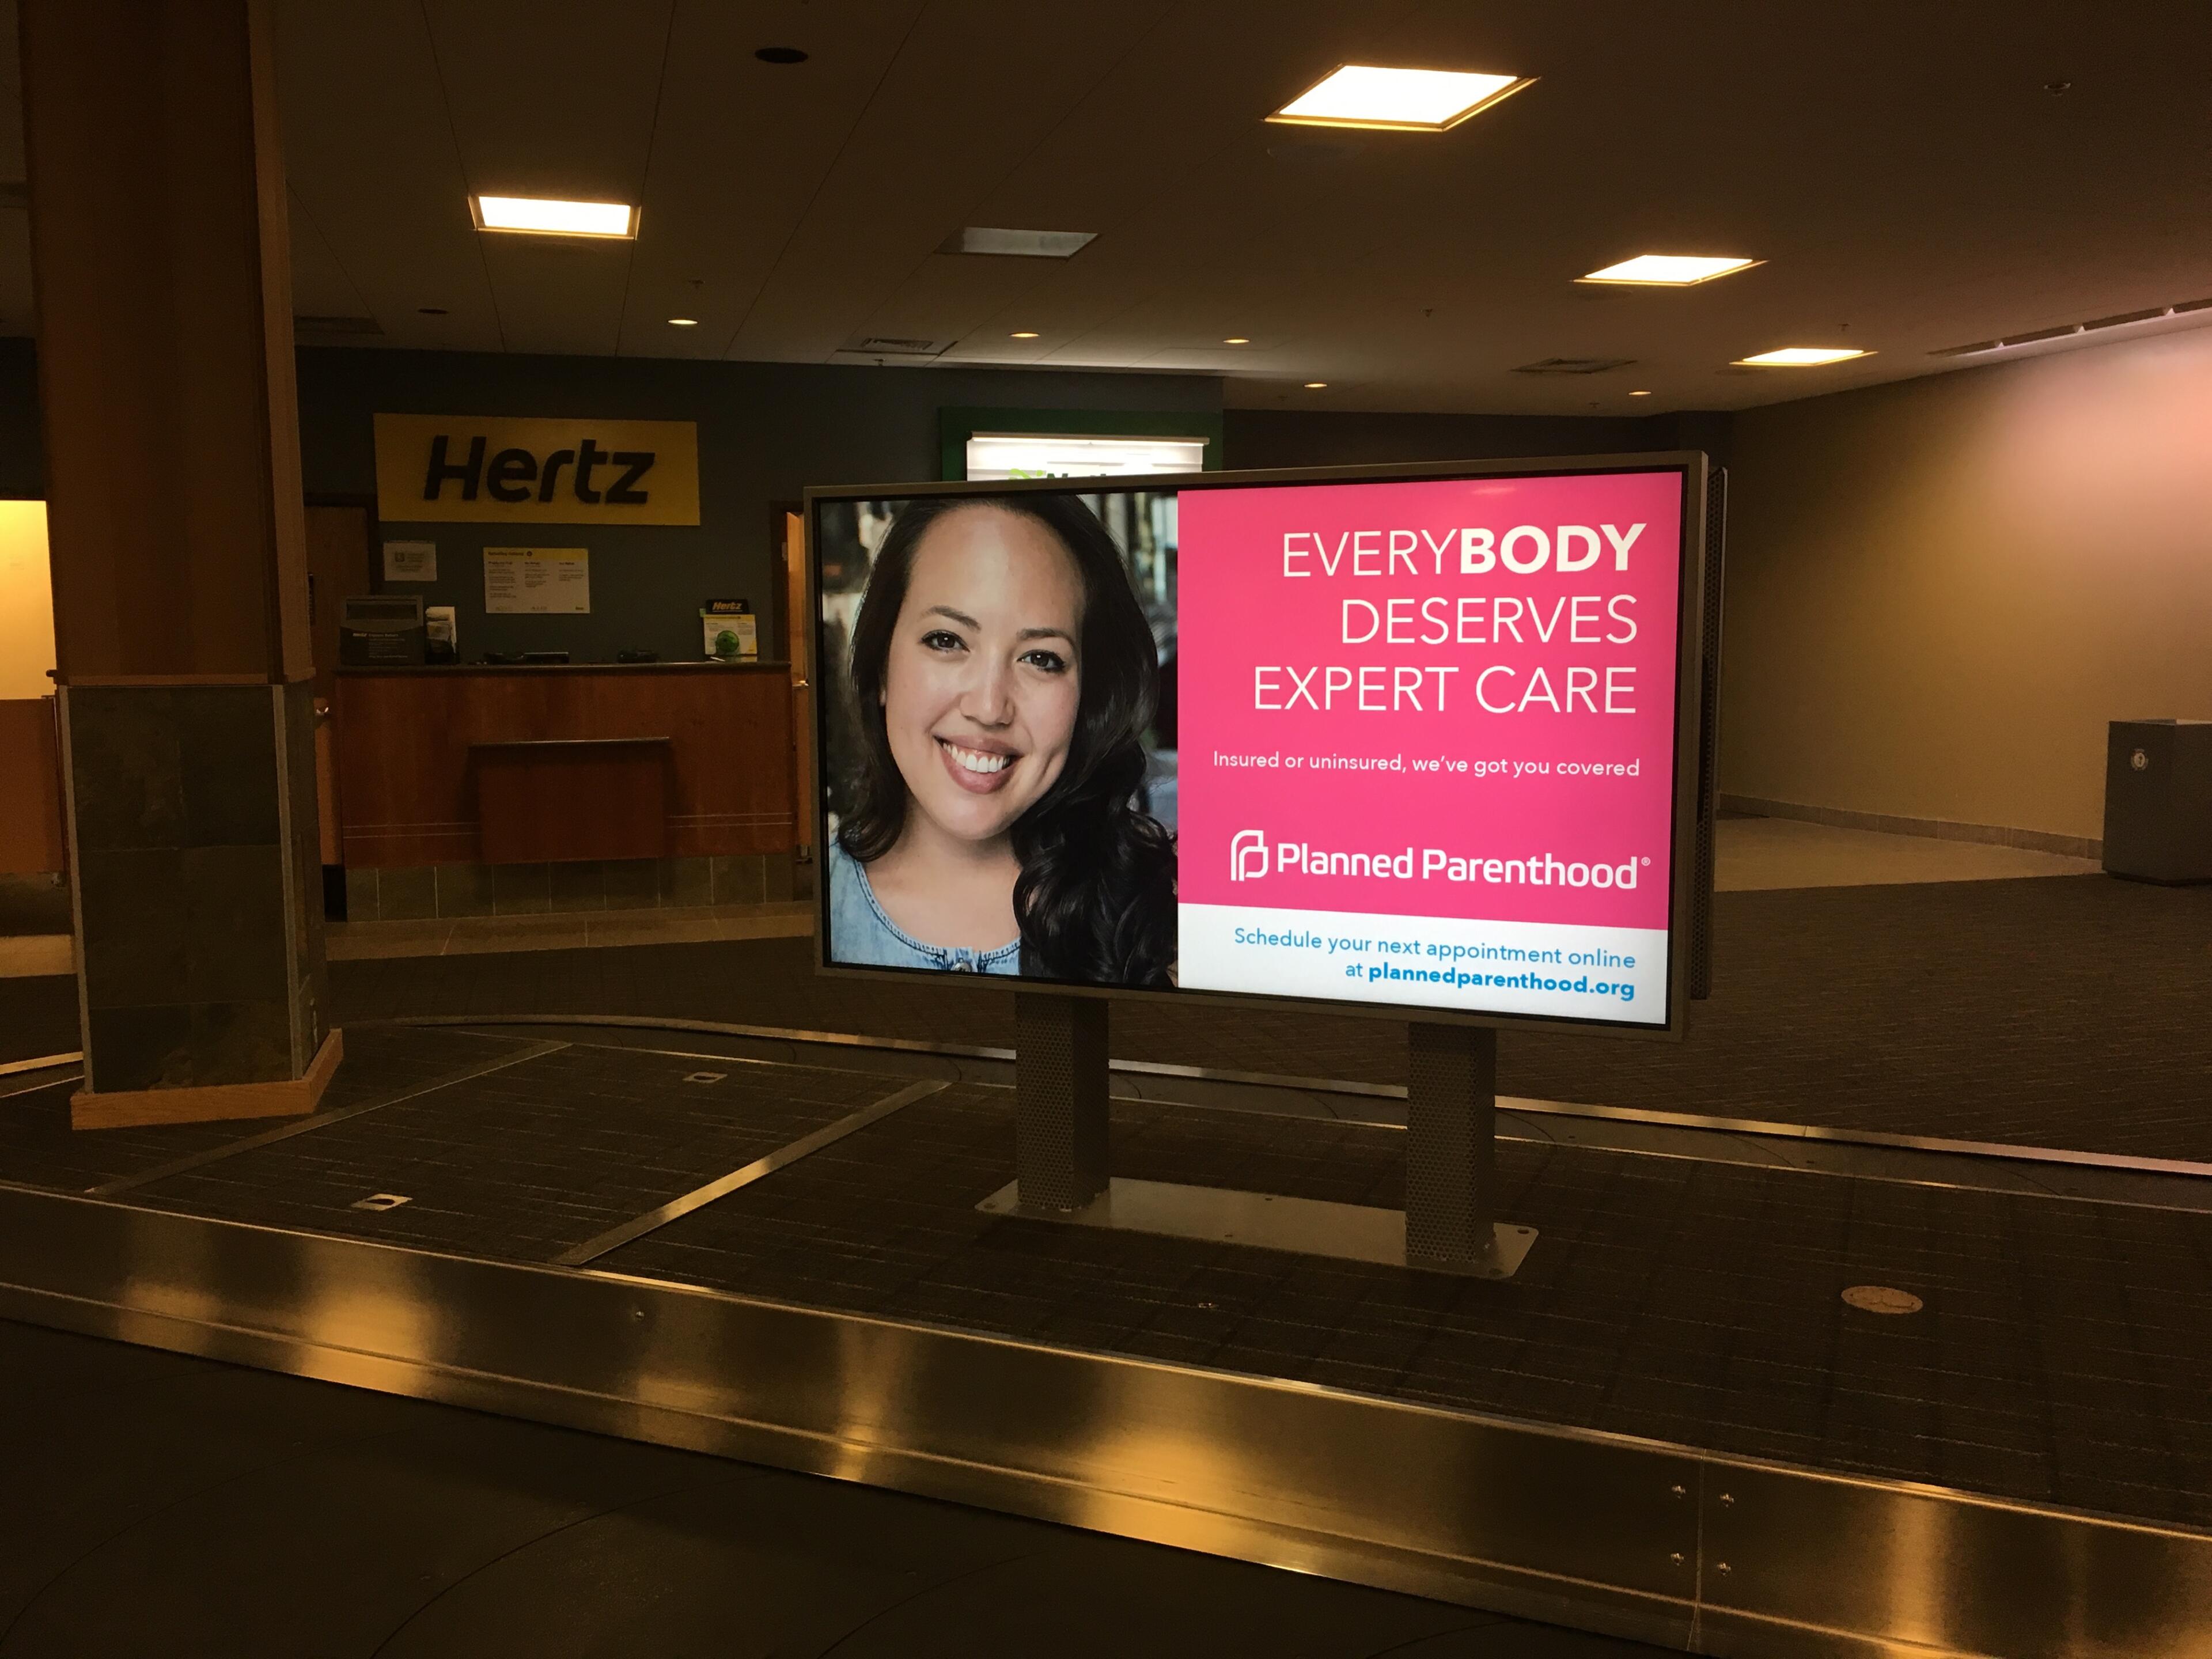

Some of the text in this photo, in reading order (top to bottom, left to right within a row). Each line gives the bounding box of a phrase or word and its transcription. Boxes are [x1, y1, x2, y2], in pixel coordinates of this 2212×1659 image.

[423, 435, 656, 505] Hertz
[1283, 522, 1647, 578] EVERYBODY
[712, 601, 743, 611] Hertz
[1342, 594, 1638, 645] DESERVES
[1255, 665, 1637, 714] EXPERT CARE
[1213, 750, 1640, 779] Insured or uninsured, we’ve got you covered
[1277, 842, 1414, 879] Planned
[1234, 927, 1637, 969] Schedule your next appointment online
[1344, 961, 1635, 1003] at plannedparenthood.org
